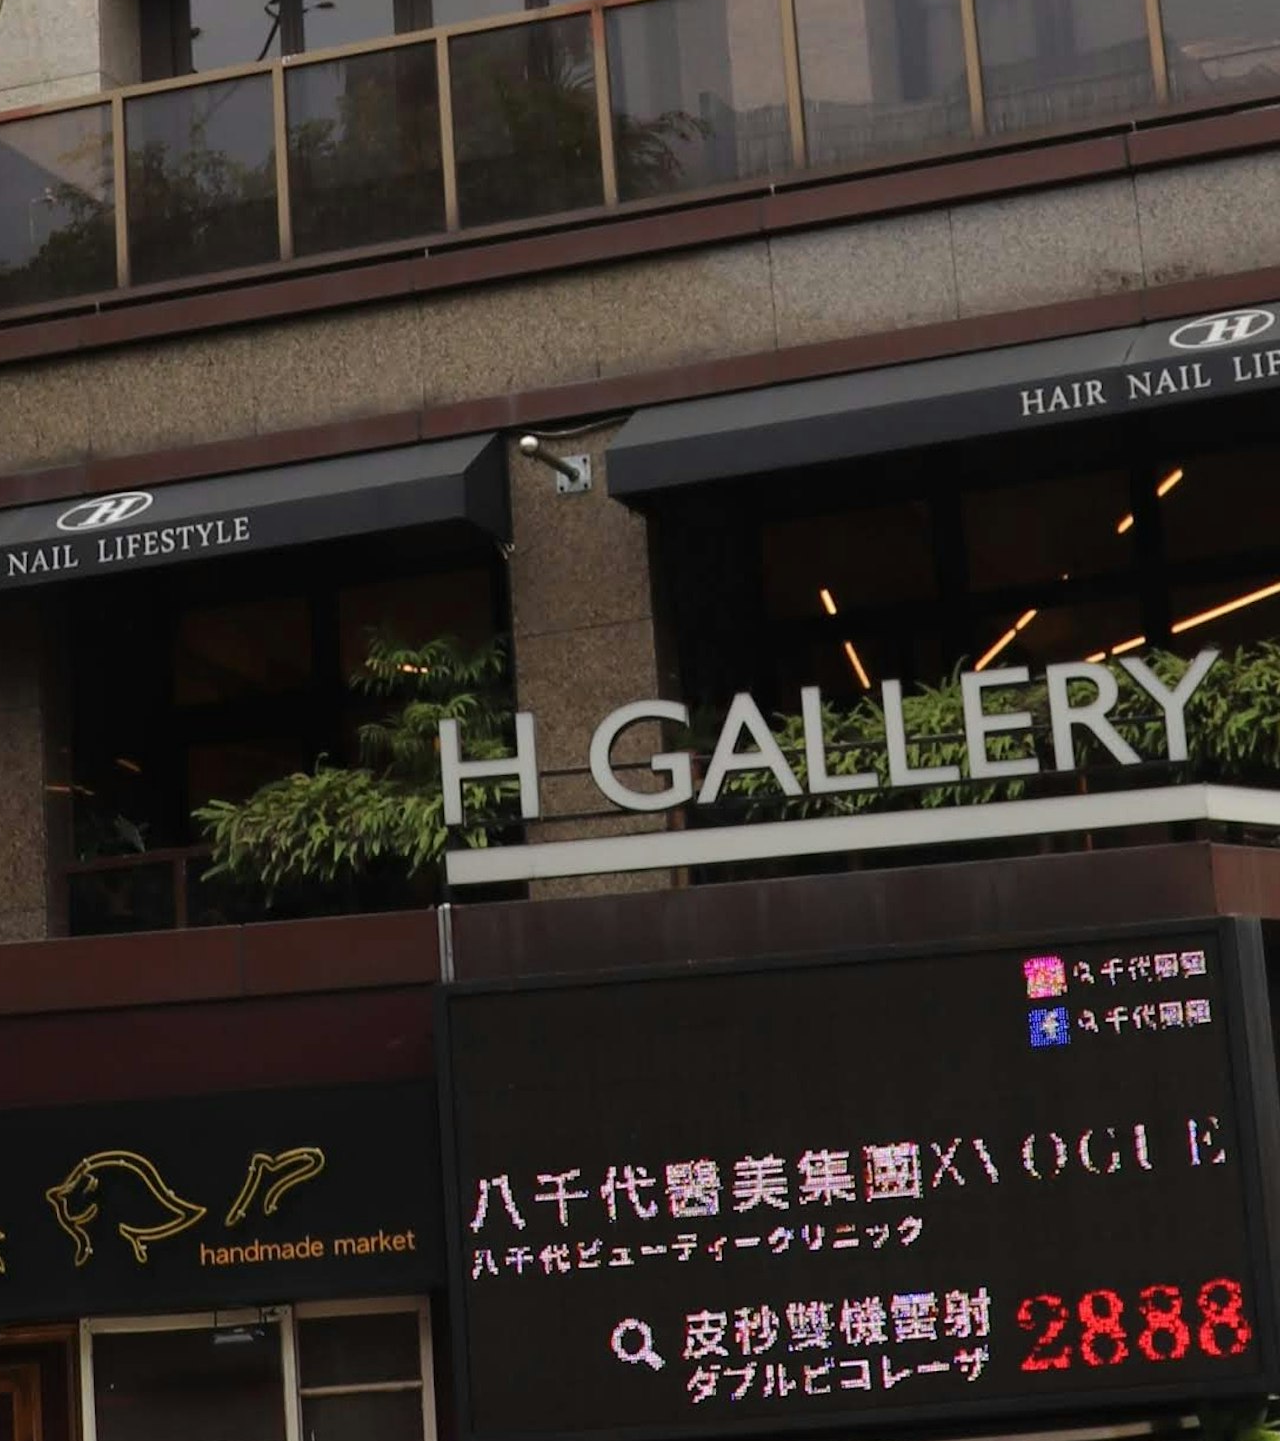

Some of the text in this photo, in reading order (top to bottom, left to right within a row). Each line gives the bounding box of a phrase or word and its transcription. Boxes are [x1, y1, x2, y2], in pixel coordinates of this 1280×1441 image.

[1020, 379, 1107, 416] HAIR
[1127, 363, 1212, 400] NAIL
[7, 545, 79, 578] NAIL
[97, 516, 251, 565] LIFESTYLE
[438, 648, 1221, 826] H GALLERY
[199, 1234, 324, 1266] handmade
[333, 1228, 416, 1258] market
[1017, 1276, 1253, 1372] 2888
